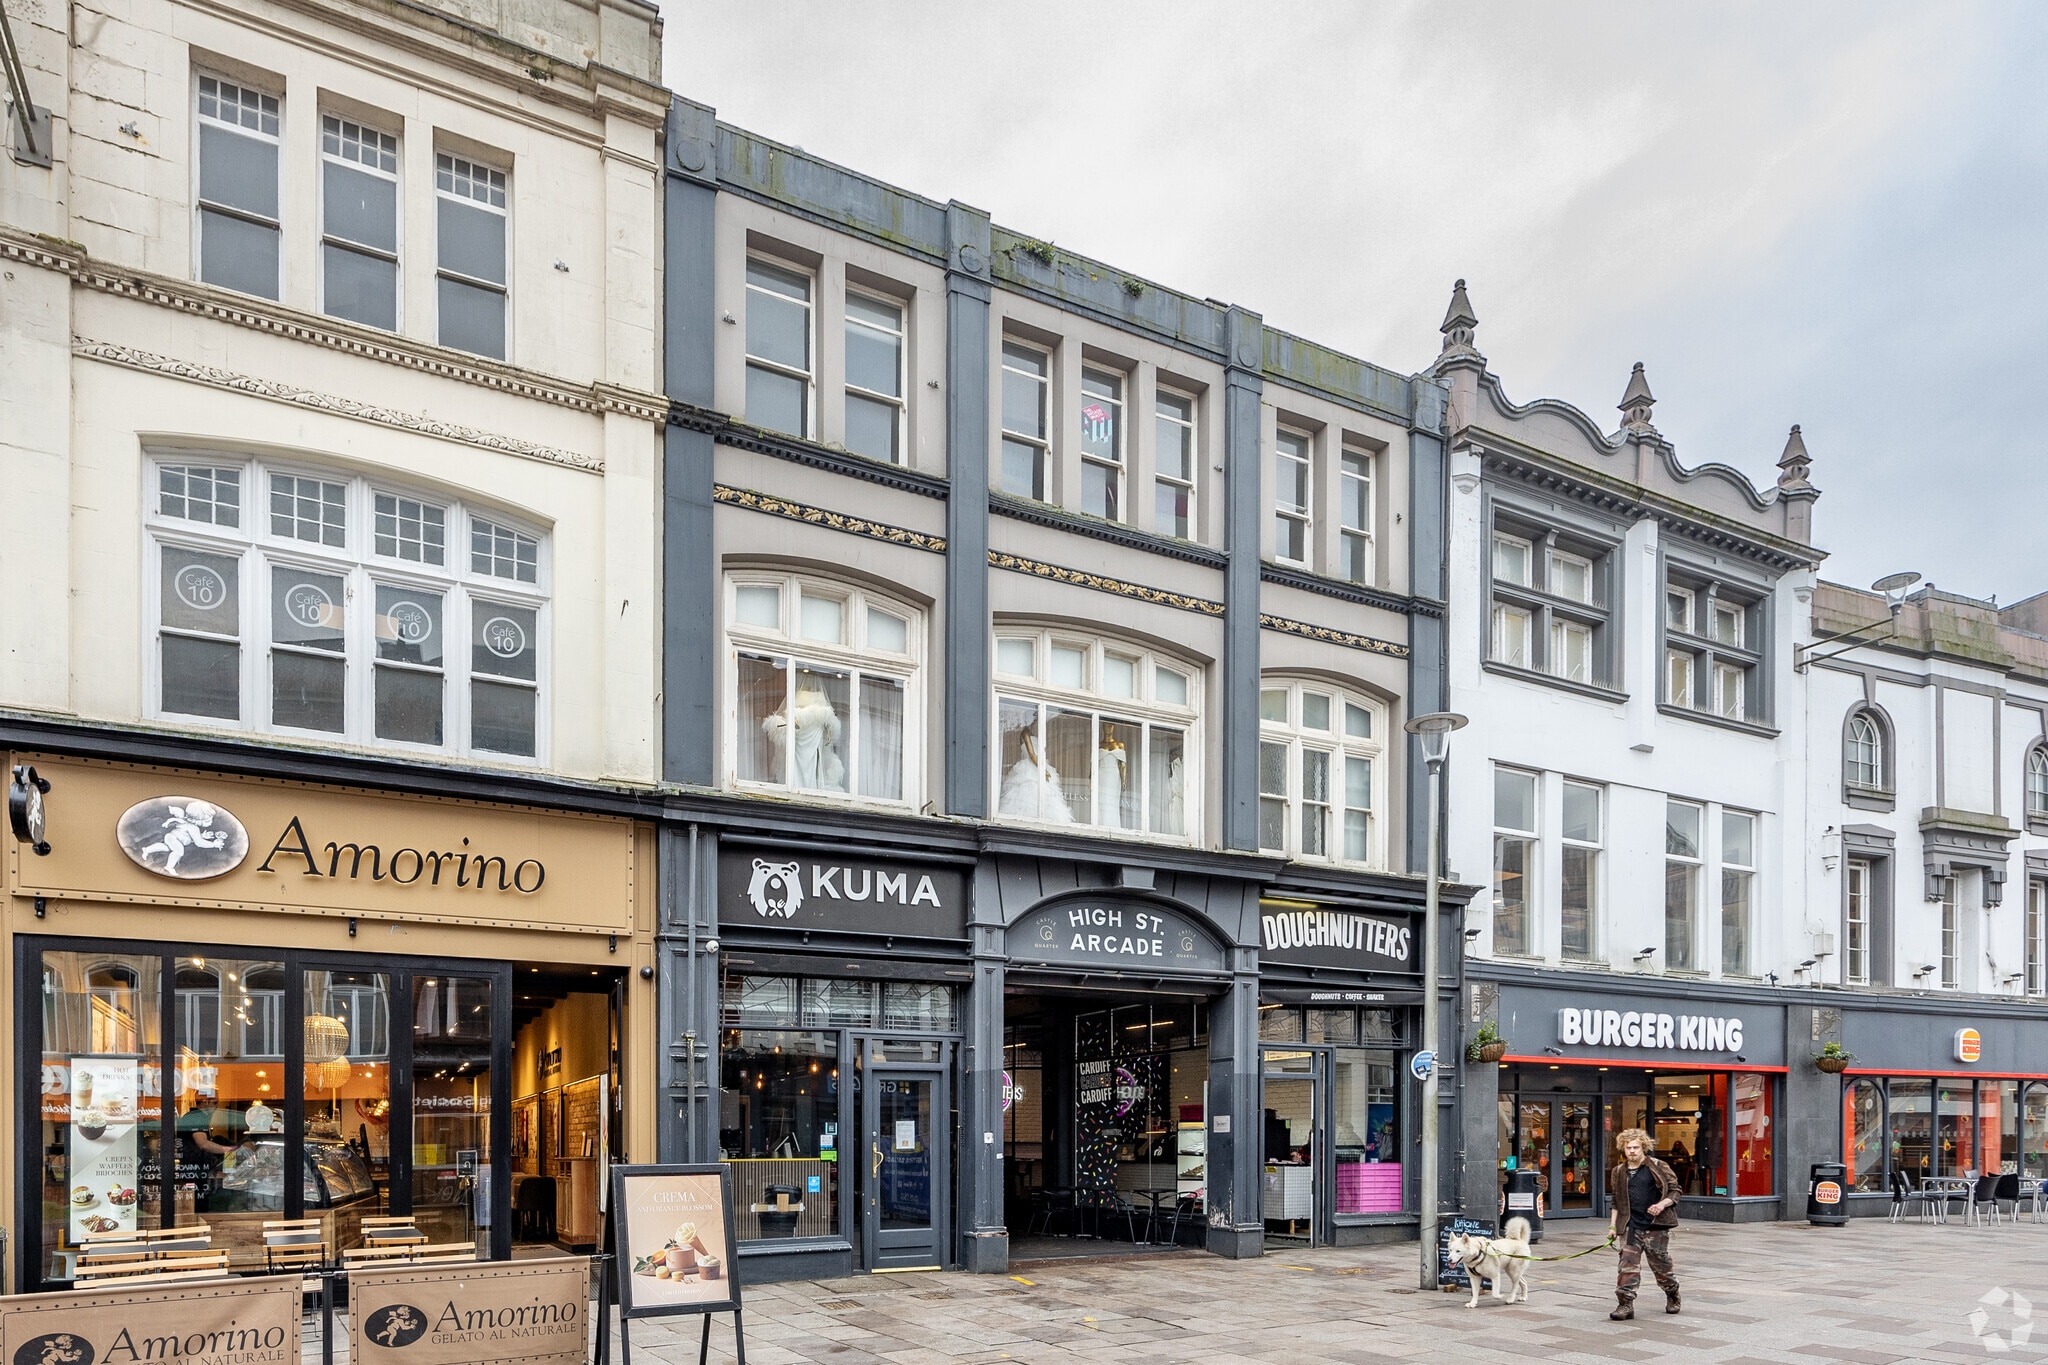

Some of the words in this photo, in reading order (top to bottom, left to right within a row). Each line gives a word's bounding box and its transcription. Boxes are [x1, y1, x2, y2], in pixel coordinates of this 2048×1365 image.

[185, 573, 214, 589] Café
[188, 585, 213, 603] 10
[295, 592, 322, 606] Café
[297, 603, 320, 621] 10
[396, 609, 422, 623] Café
[398, 621, 420, 637] 10
[491, 625, 516, 638] Café
[493, 636, 514, 652] 10
[256, 815, 545, 893] Amorino
[812, 864, 941, 907] KUMA
[1036, 917, 1056, 926] CASTLE
[1068, 908, 1122, 928] HIGH
[1135, 912, 1165, 936] ST.
[1262, 911, 1411, 961] DOUGHNUTTERS
[1070, 933, 1163, 956] ARCADE
[1310, 992, 1341, 1000] DOUGHNUTS
[1345, 992, 1363, 1001] COFFEE
[1559, 1008, 1674, 1049] BURGER
[1677, 1015, 1743, 1052] KING
[1079, 1060, 1111, 1075] CARDIFF
[1081, 1087, 1112, 1104] CARDIFF
[653, 1191, 696, 1203] CREMA
[681, 1204, 713, 1212] BLOSSOM
[431, 1296, 577, 1333] Amorino
[431, 1331, 485, 1345] GELATO
[489, 1329, 506, 1340] AL
[511, 1322, 577, 1339] NATURALE
[100, 1320, 285, 1364] Amorino
[201, 1349, 285, 1365] NATURALE
